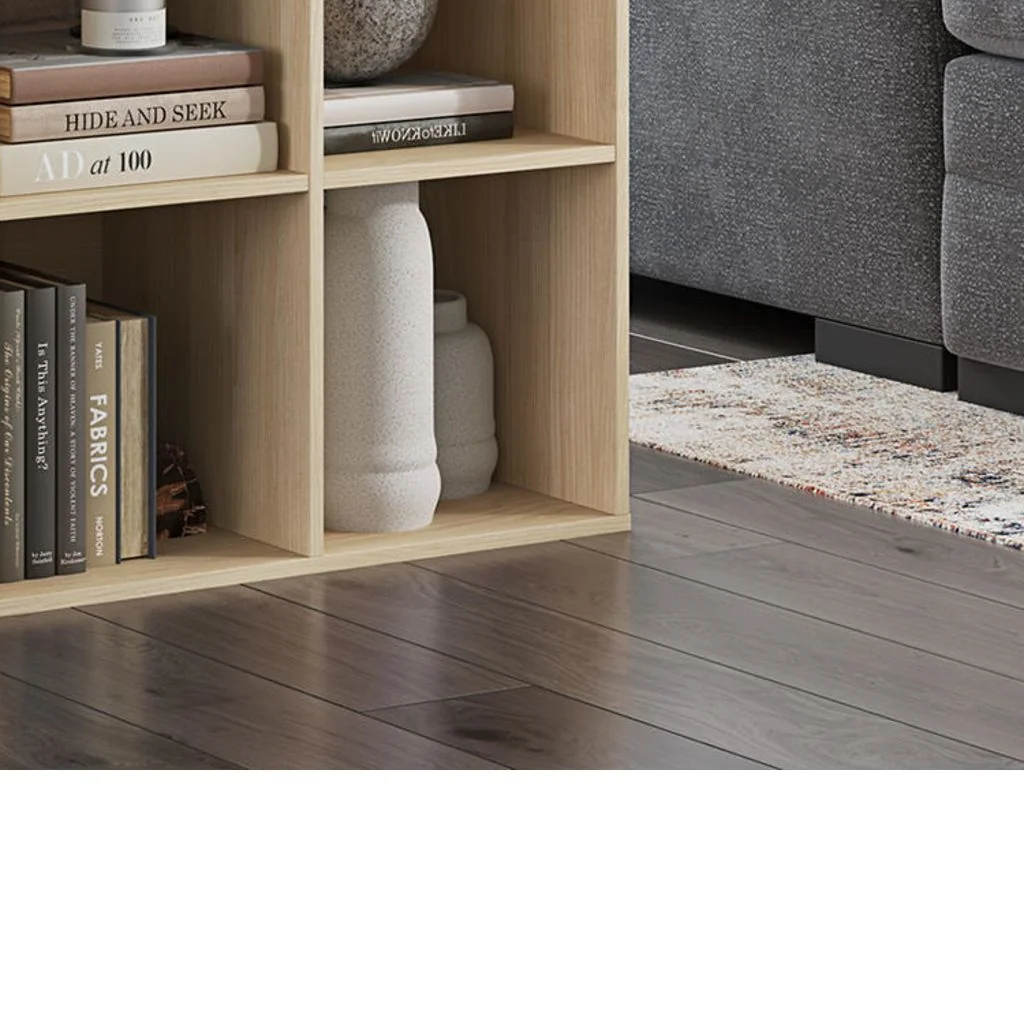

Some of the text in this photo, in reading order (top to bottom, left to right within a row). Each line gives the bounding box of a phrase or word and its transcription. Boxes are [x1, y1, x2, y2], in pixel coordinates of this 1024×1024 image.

[65, 101, 227, 132] HIDE AND SEEK
[35, 149, 152, 182] AD at 100
[3, 341, 14, 365] The
[94, 341, 103, 369] YATES
[1, 369, 14, 412] Origins
[35, 342, 49, 470] Is This Anything?
[1, 415, 14, 430] of
[90, 394, 108, 497] FABRICS
[95, 516, 104, 556] NORTON
